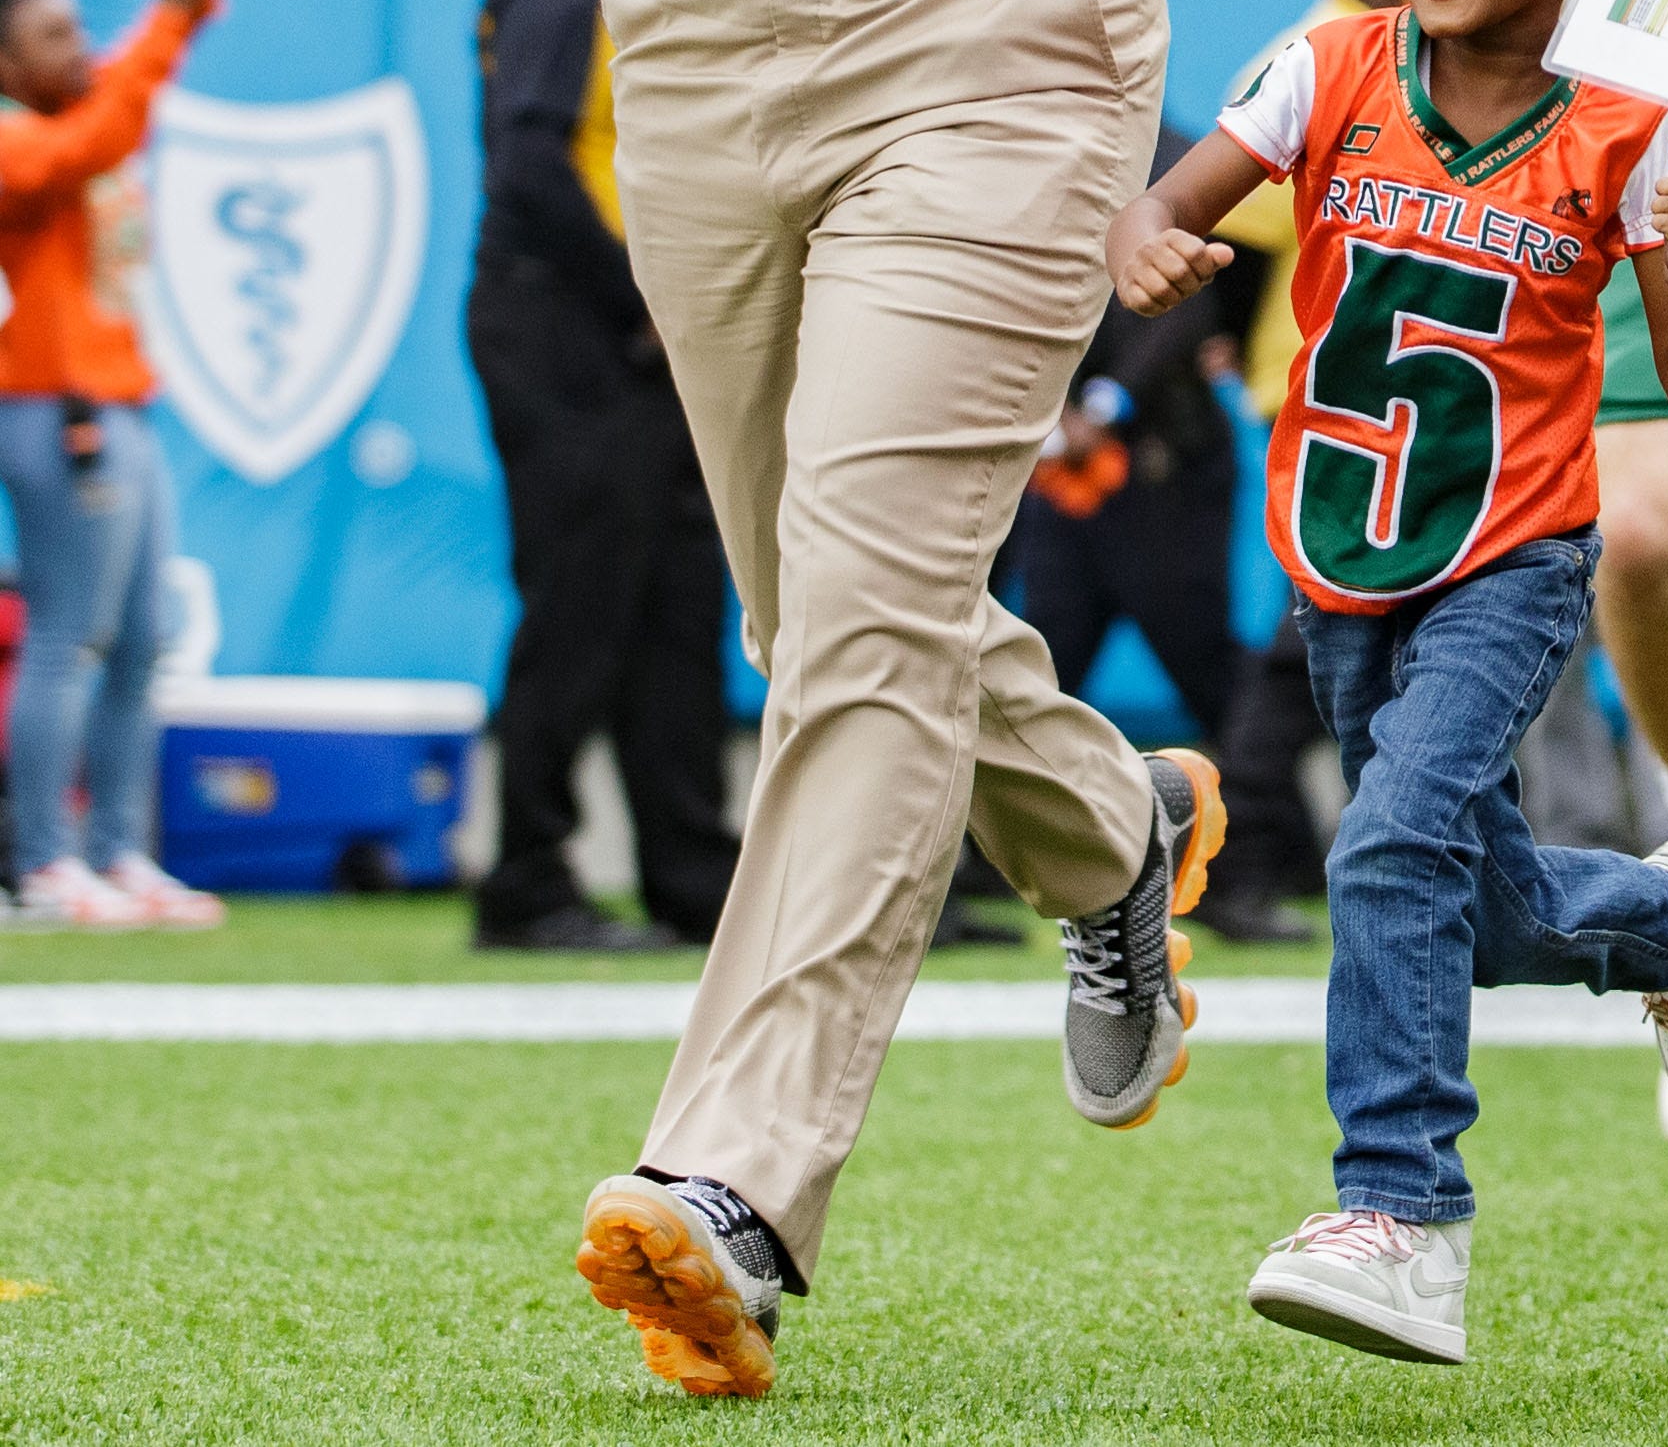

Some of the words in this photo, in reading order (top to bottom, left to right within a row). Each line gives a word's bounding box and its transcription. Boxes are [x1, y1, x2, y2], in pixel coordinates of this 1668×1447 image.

[1467, 129, 1536, 180] RATTLERS
[1533, 100, 1567, 135] FAMU
[1321, 175, 1584, 278] RATTLERS
[1290, 235, 1518, 601] 5
